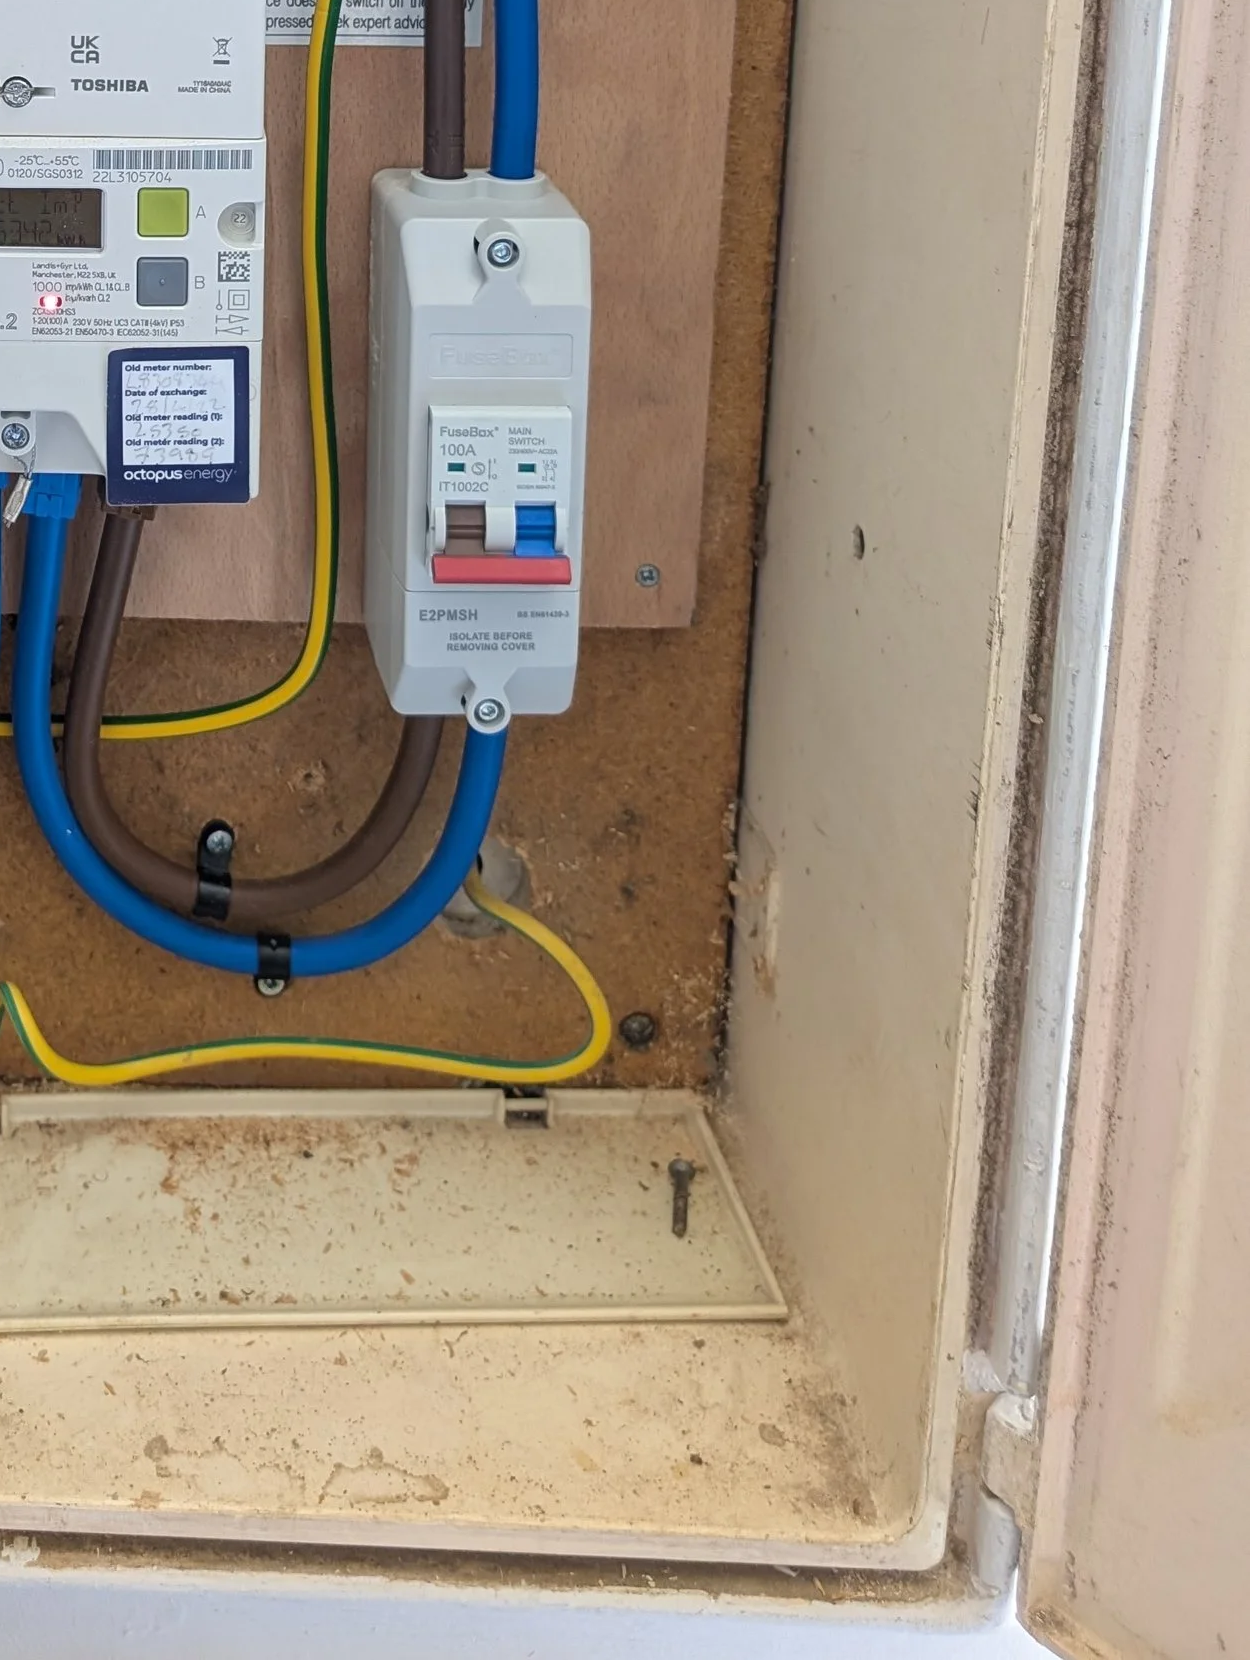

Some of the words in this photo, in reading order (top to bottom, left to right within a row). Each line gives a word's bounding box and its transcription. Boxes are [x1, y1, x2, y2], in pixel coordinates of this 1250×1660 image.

[352, 16, 391, 31] expert
[70, 35, 100, 49] UK
[70, 50, 100, 64] CA
[71, 79, 149, 92] TOSHIBA
[7, 168, 84, 180] 0120/SGS0312
[92, 171, 172, 184] 22L3105704
[195, 205, 206, 219] A
[195, 276, 205, 289] B
[125, 364, 141, 372] Old
[143, 364, 170, 372] meter
[125, 389, 146, 397] Date
[148, 388, 158, 396] of
[160, 389, 207, 398] exchange:
[125, 414, 141, 422] Old
[143, 414, 170, 422] meter
[173, 413, 208, 422] reading
[508, 427, 531, 435] MAIN
[508, 437, 545, 446] SWITCH
[439, 444, 476, 456] 100A
[439, 481, 489, 492] IT1002C
[419, 609, 478, 621] E2PMSH
[449, 632, 490, 641] ISOLATE
[493, 631, 533, 640] BEFORE
[447, 642, 498, 651] REMOVING
[501, 642, 536, 651] COVER
